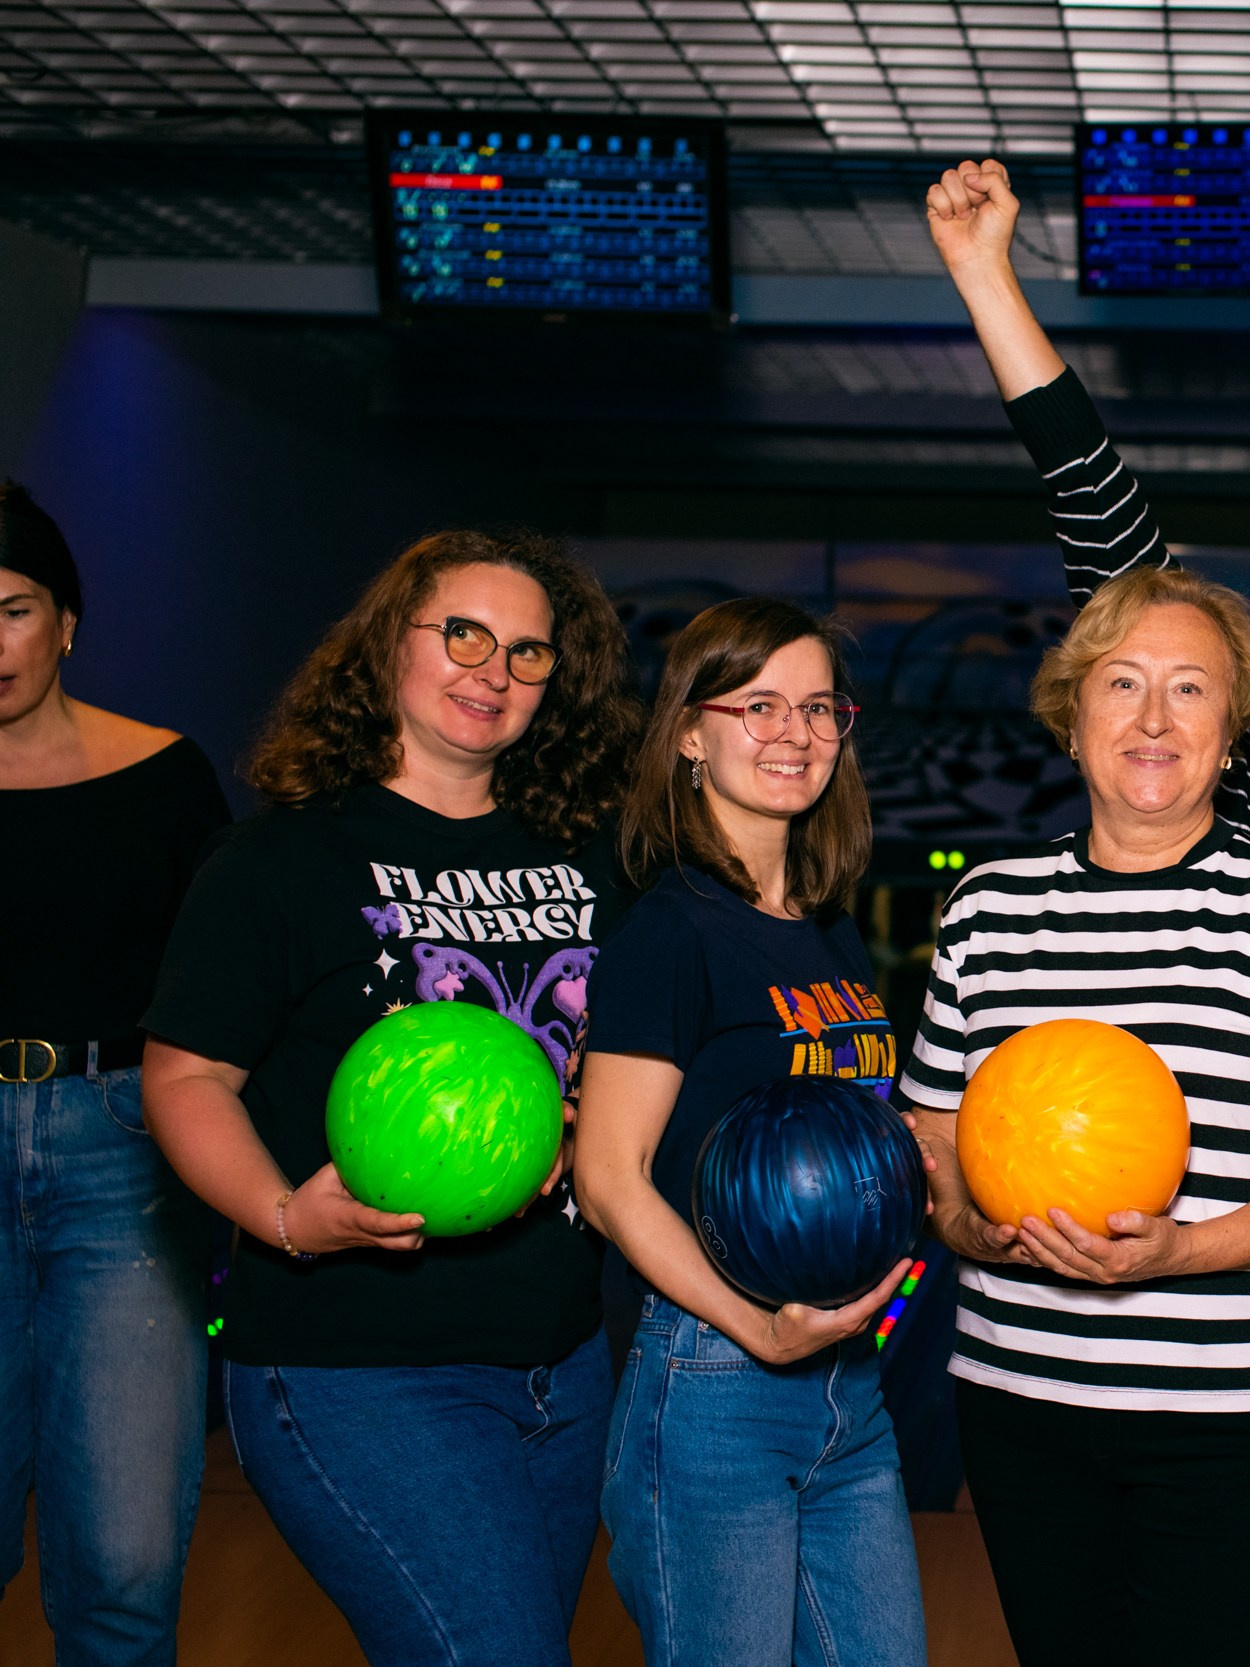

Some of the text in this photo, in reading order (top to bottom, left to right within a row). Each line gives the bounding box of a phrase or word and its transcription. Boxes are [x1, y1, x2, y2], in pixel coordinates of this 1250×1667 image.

[369, 862, 597, 907] FLOWER
[390, 901, 594, 942] ENERGY
[701, 1215, 728, 1259] 8
